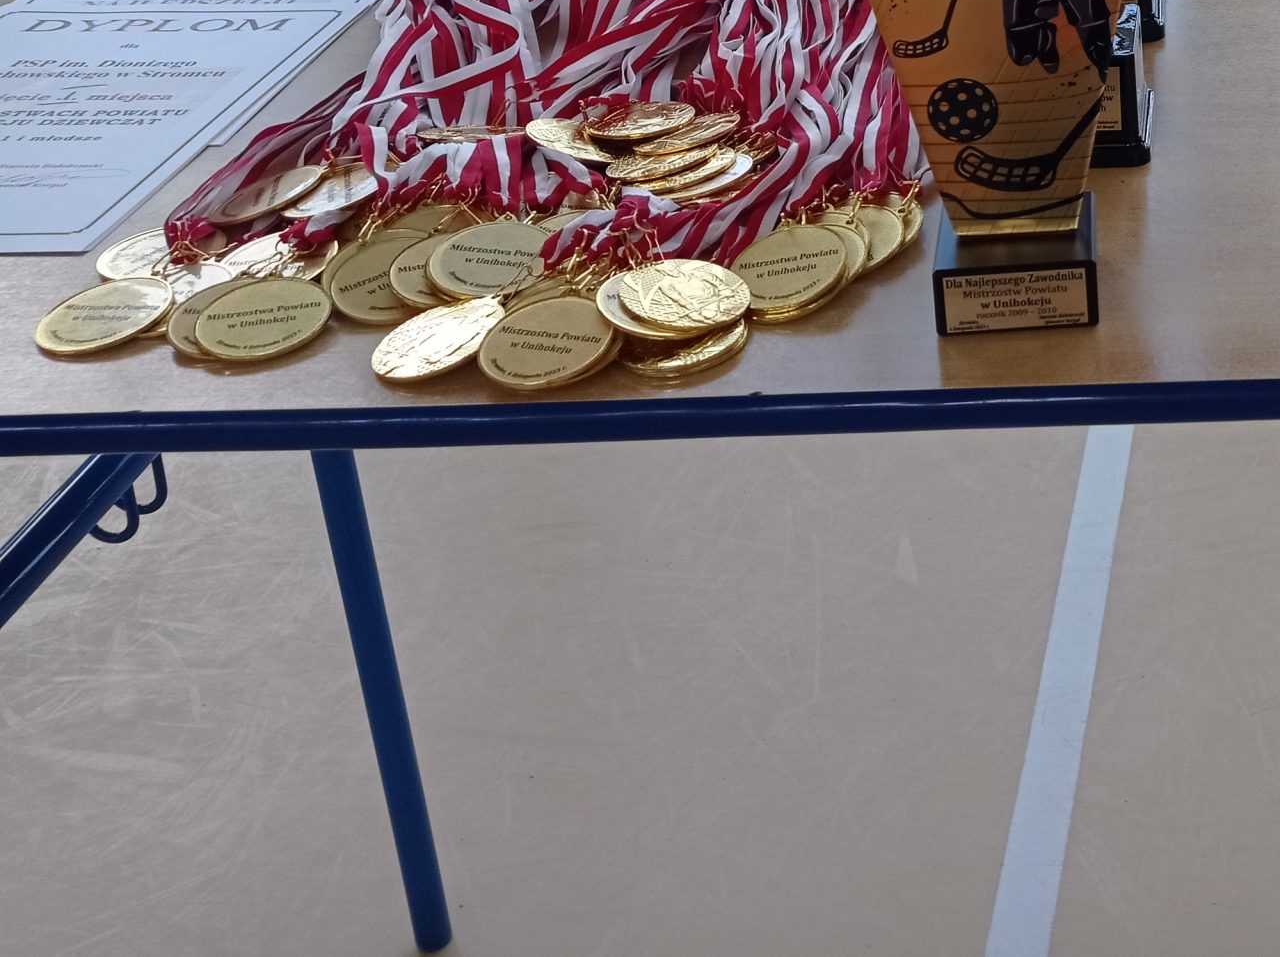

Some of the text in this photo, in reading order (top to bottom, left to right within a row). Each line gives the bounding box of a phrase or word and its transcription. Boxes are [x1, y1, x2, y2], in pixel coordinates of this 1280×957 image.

[21, 17, 292, 33] DYPLOM
[10, 59, 198, 69] PSP im. Dionizego
[137, 70, 227, 79] Stromcu
[86, 93, 174, 103] miejsca
[92, 109, 190, 117] POWIATU
[37, 119, 162, 127] DZIEWCZĄT
[450, 244, 512, 257] Mistrzostwa
[738, 248, 839, 271] Mistrzostwa Powiatu
[756, 263, 817, 280] w Unihokeju
[338, 270, 391, 295] Mistrzost
[945, 270, 1084, 290] Dla Najlepszego Zawodnika
[963, 284, 1068, 299] Mistrzostw Powiatu
[980, 296, 1052, 310] w Unihokeju
[206, 308, 274, 322] Mistrzostwa
[276, 301, 321, 313] Powiatu
[1008, 308, 1028, 317] 2009
[1037, 306, 1057, 315] 2010
[240, 315, 297, 328] Unihokeju
[499, 325, 602, 344] Mistrzostwa Powiatu
[521, 341, 573, 354] Unihokeju
